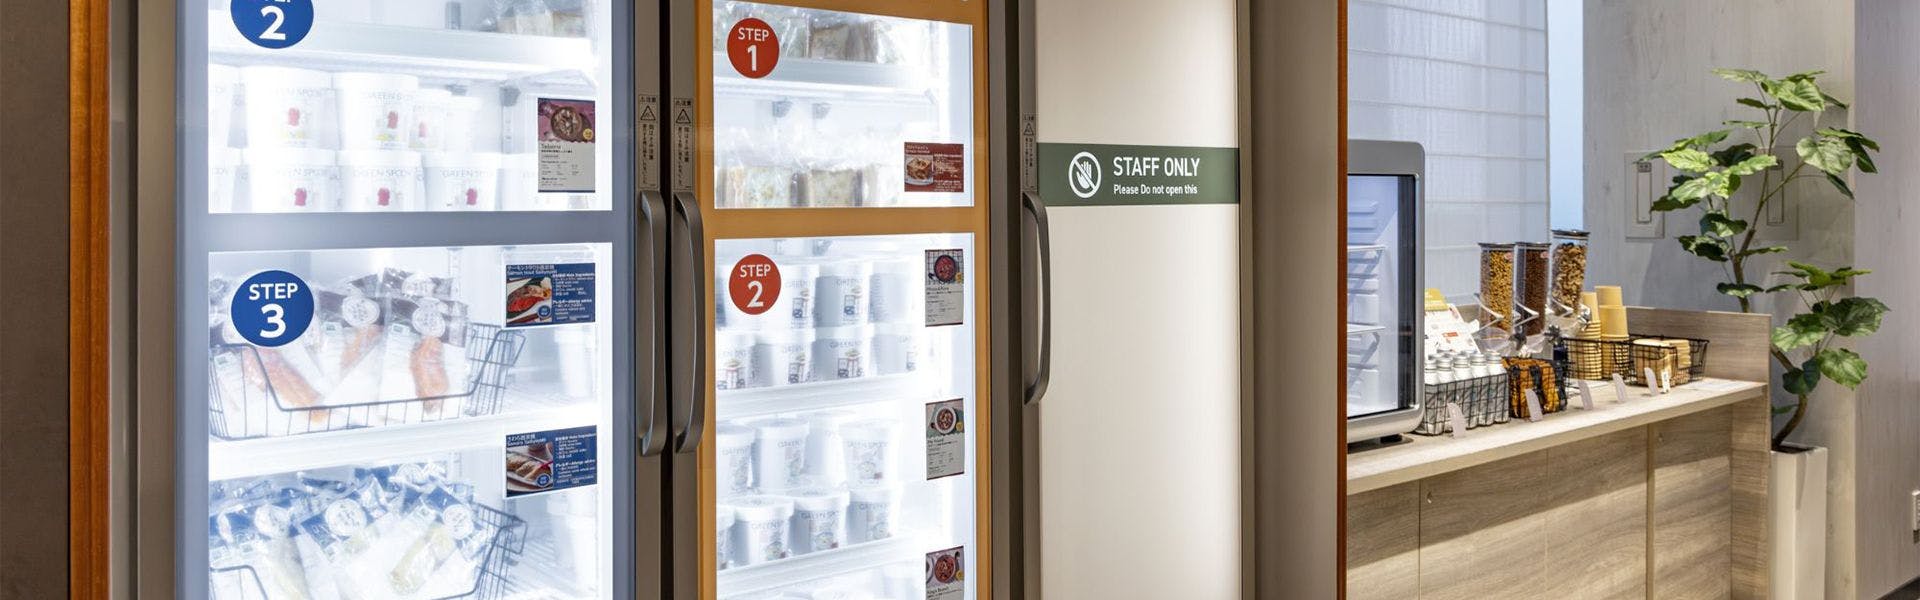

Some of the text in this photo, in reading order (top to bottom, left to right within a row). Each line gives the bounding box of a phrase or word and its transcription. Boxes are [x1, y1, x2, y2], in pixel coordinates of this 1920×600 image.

[259, 5, 286, 40] 2
[738, 27, 769, 42] STEP
[747, 44, 757, 72] 1
[1113, 156, 1200, 177] STAFF ONLY
[1113, 184, 1198, 197] Please Do not open this
[740, 263, 772, 278] STEP
[248, 282, 299, 301] STEP
[746, 280, 764, 308] 2
[260, 303, 287, 339] 3
